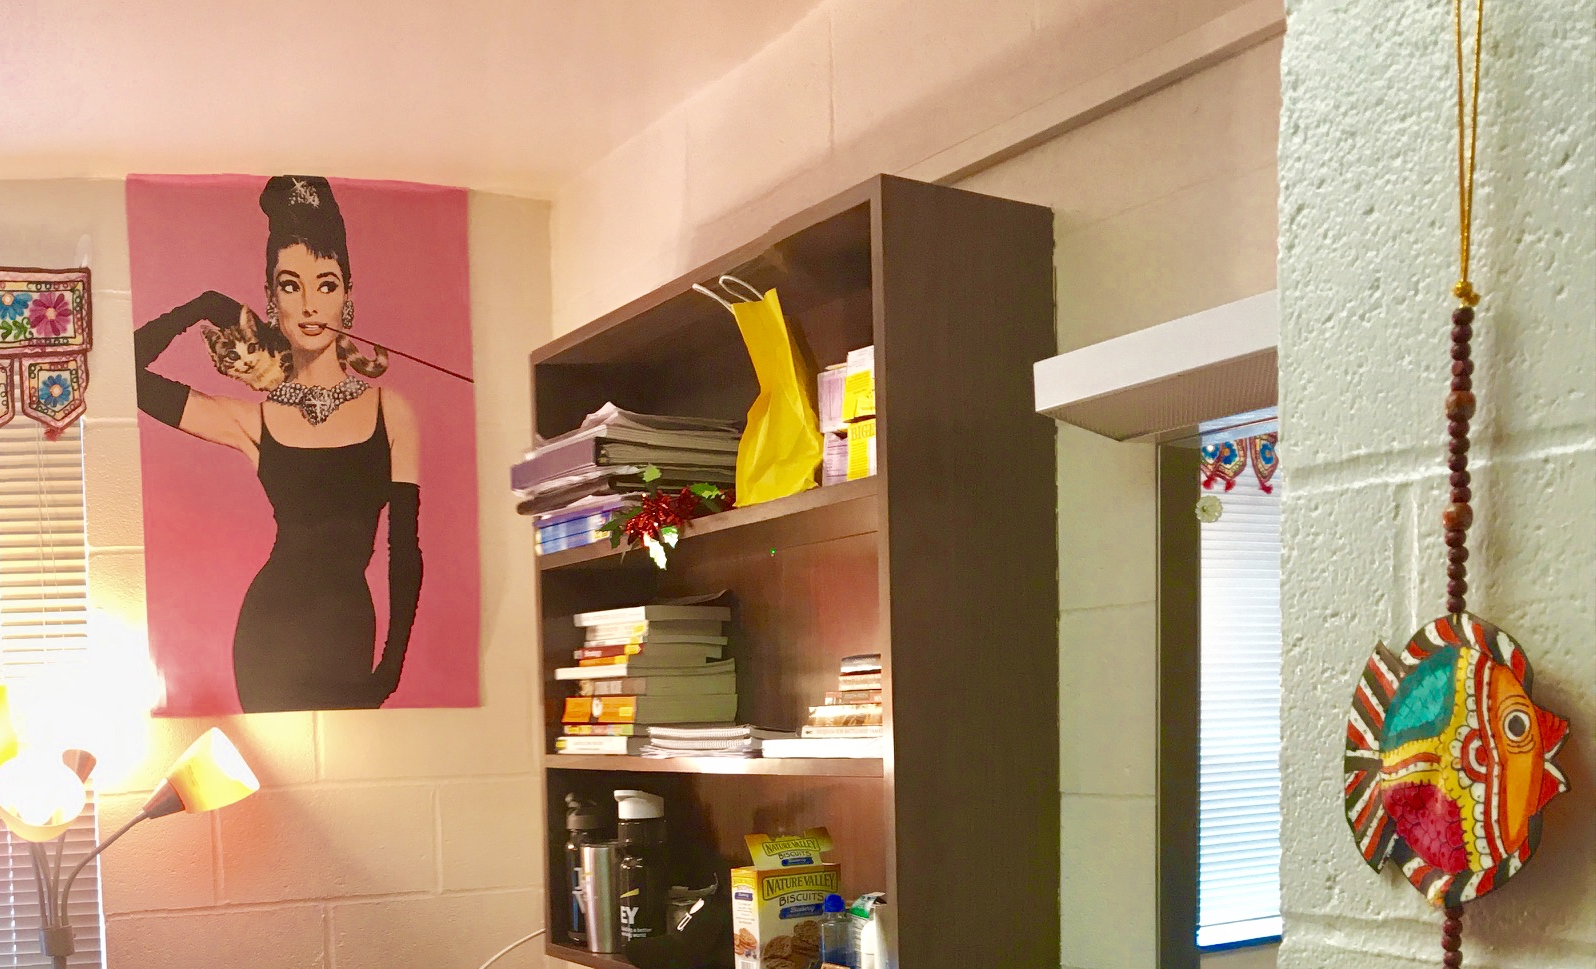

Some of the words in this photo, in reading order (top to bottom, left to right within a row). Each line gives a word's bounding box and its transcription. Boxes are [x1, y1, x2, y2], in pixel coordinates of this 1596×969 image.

[765, 840, 791, 855] NATURE
[791, 838, 817, 850] VALLEY
[778, 851, 811, 860] BISCUITS
[766, 877, 803, 897] NATURE
[802, 873, 835, 890] VALLEY
[778, 892, 824, 907] BISCUITS
[620, 905, 639, 924] EY
